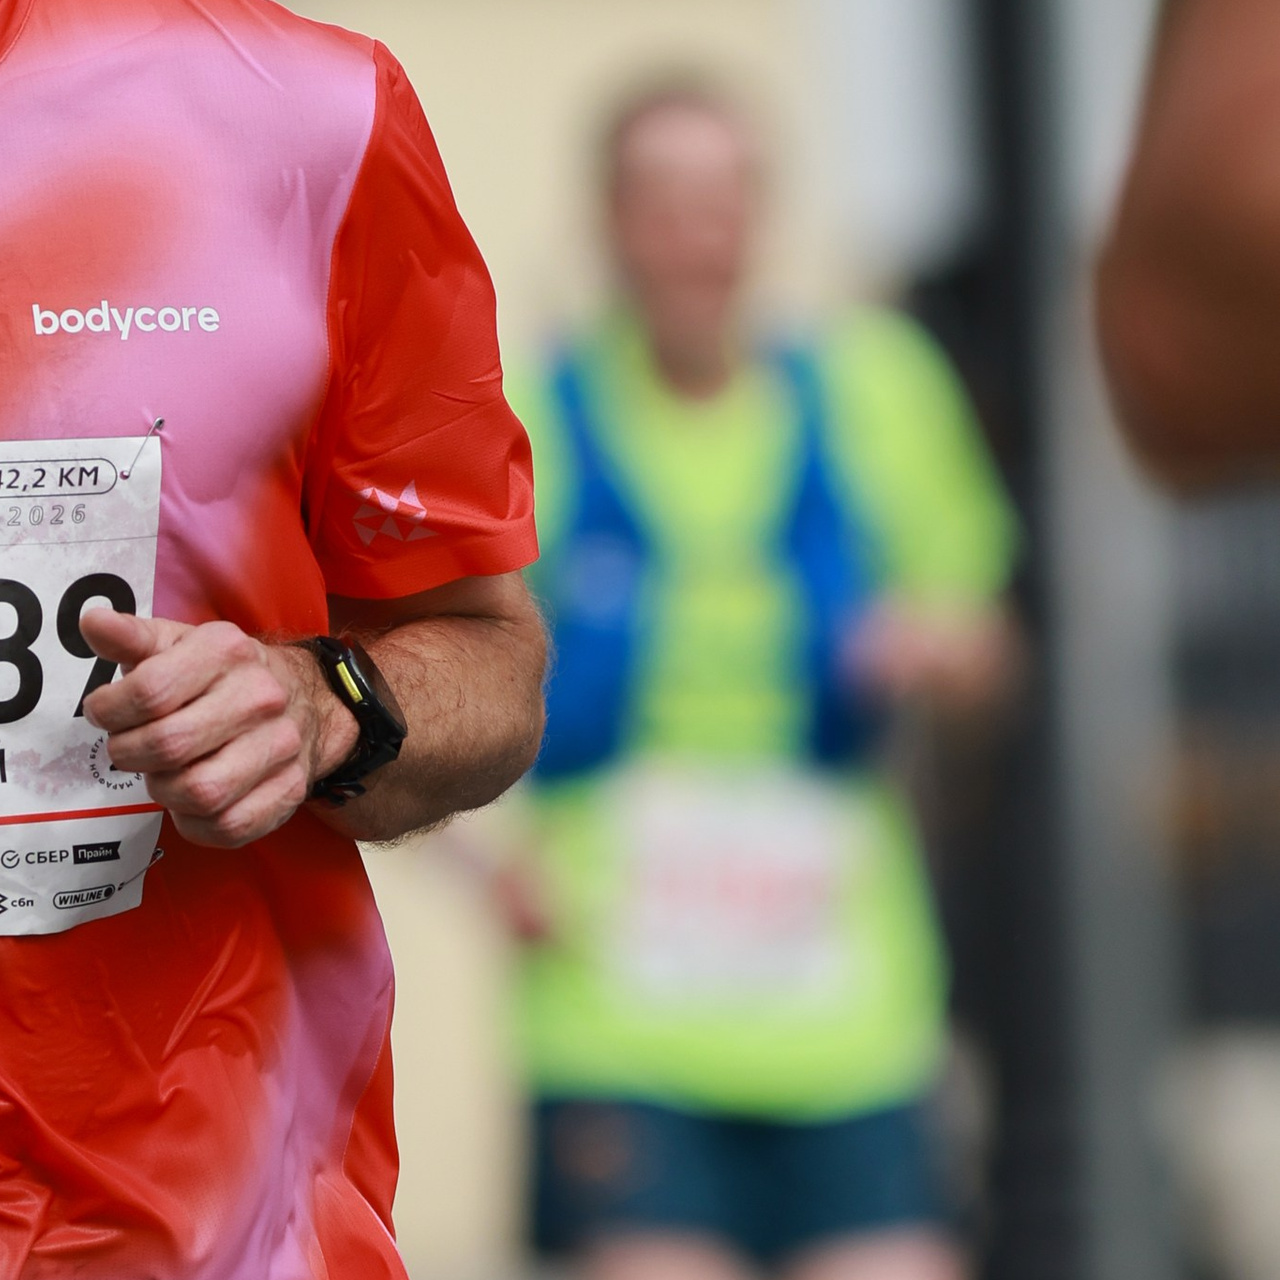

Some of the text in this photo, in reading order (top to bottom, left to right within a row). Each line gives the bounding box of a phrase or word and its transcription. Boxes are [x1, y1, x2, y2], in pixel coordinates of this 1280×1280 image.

[32, 300, 220, 340] bodycore
[58, 466, 100, 487] КМ
[7, 503, 87, 527] 2026
[25, 848, 113, 864] СБЕР Прайм
[11, 898, 34, 908] сбп
[58, 890, 103, 906] WINLINE
